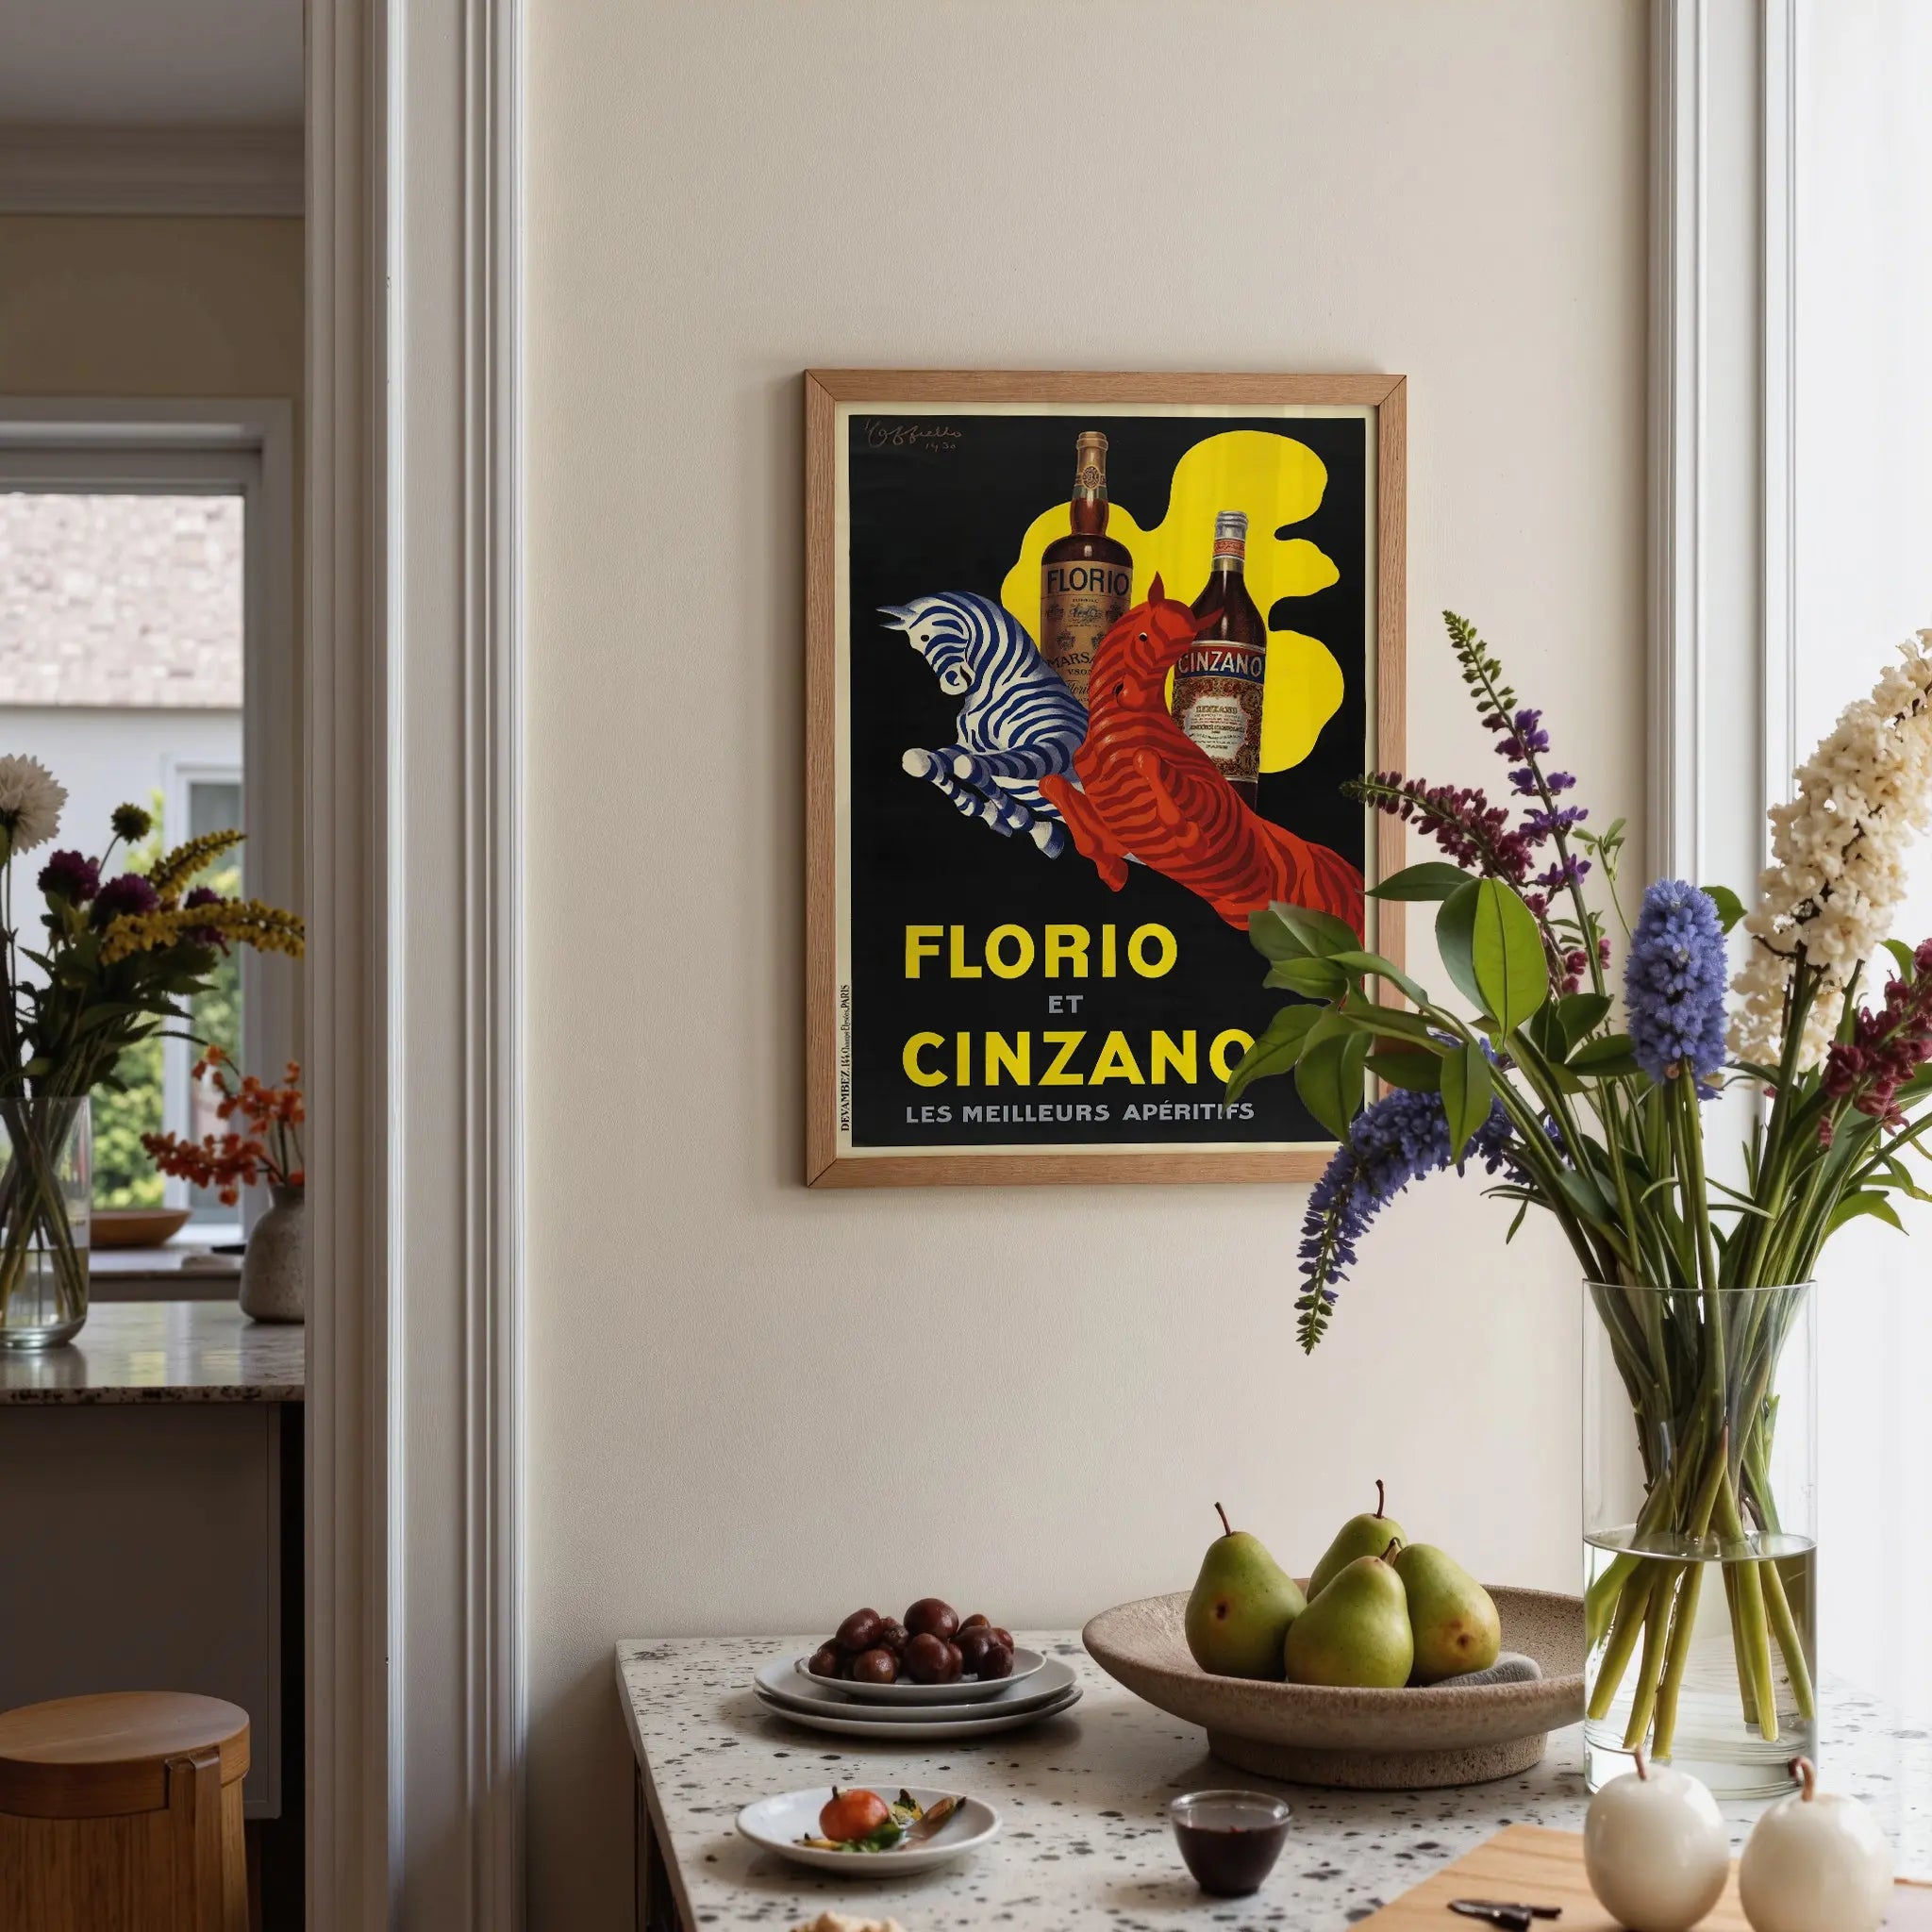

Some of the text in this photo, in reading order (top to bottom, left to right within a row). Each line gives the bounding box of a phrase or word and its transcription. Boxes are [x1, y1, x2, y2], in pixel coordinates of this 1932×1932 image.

[1047, 567, 1129, 596] FLORIO
[1178, 650, 1262, 677] CINZANO
[905, 923, 1177, 979] FLORIO
[1048, 995, 1084, 1014] ET
[902, 1028, 1256, 1088] CINZANO
[906, 1100, 1255, 1124] LES MEILLEURS APÉRITIFS
